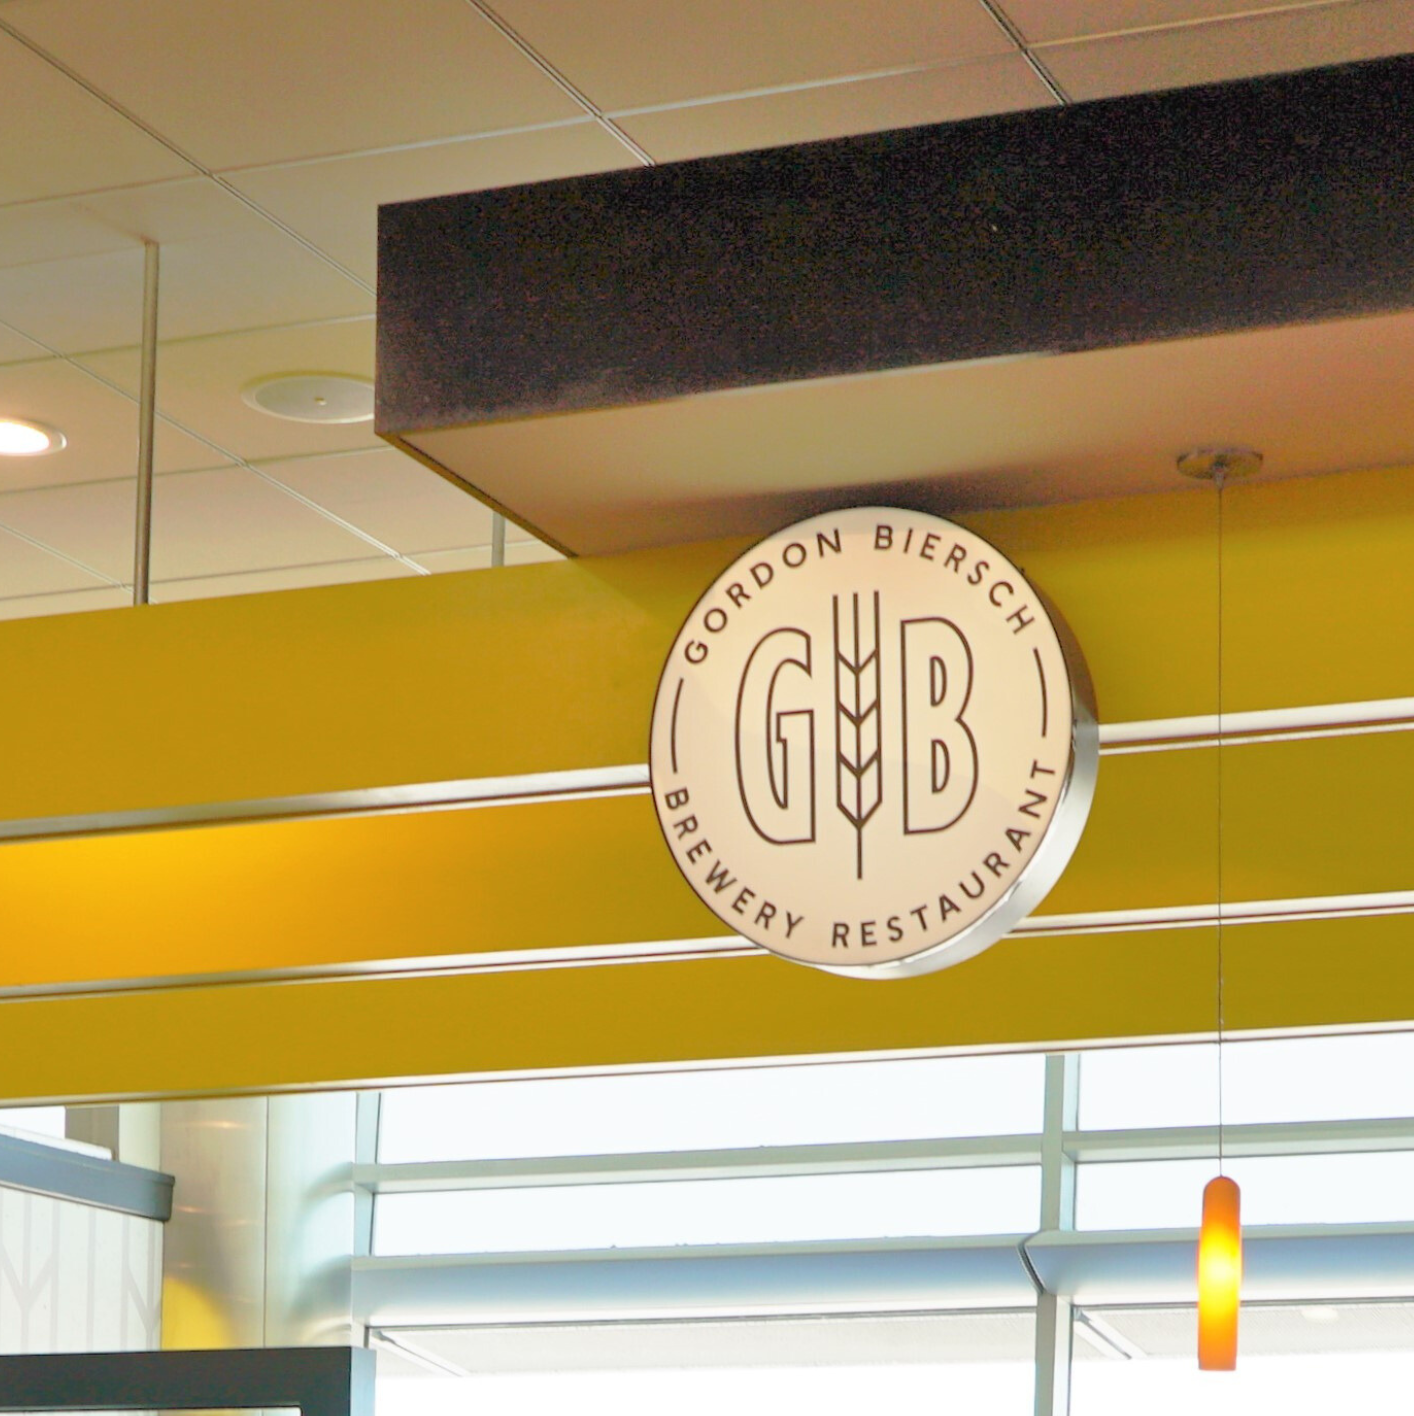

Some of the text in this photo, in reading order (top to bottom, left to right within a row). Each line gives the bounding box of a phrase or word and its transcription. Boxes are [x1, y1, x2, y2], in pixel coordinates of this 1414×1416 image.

[683, 524, 1036, 666] GORDON BIERSCH
[663, 758, 1057, 949] BREWERY RESTAURANT
